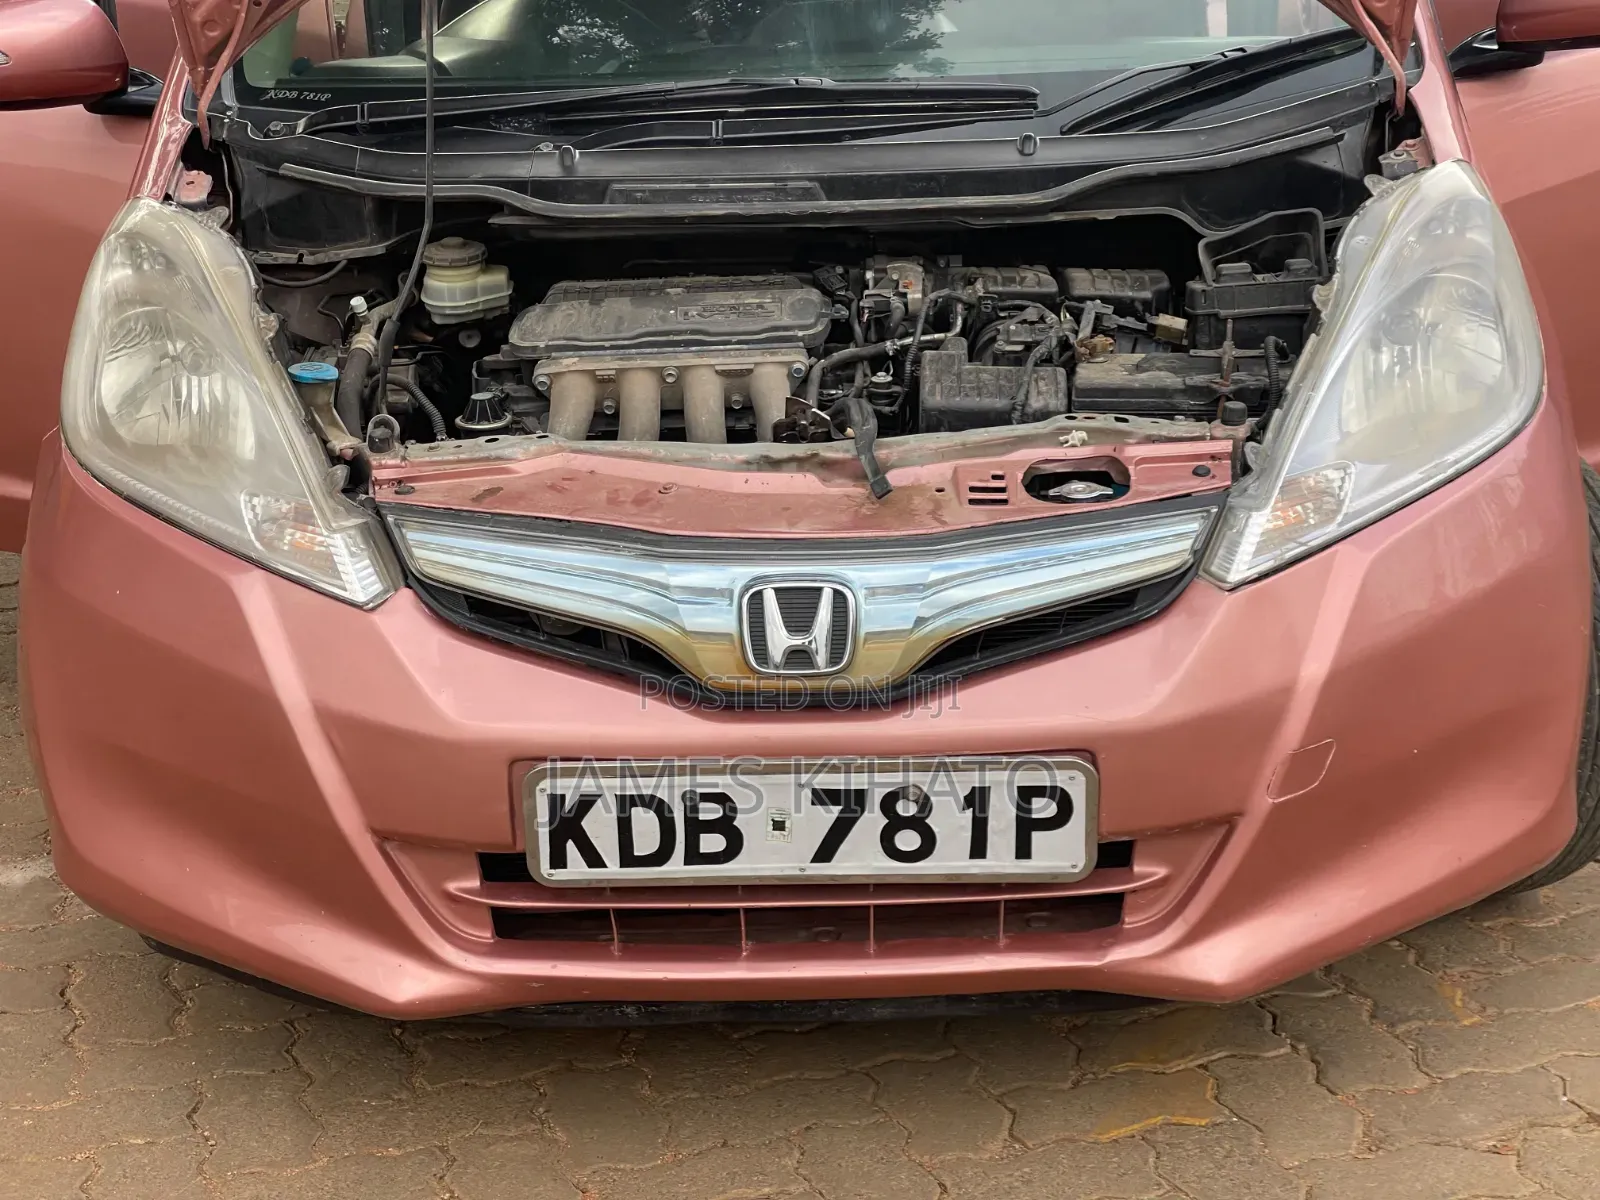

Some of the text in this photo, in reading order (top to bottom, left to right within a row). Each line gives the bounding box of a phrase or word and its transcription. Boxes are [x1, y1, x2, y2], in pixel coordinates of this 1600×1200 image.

[300, 91, 332, 101] 781P
[548, 784, 1075, 870] KDB 781P
